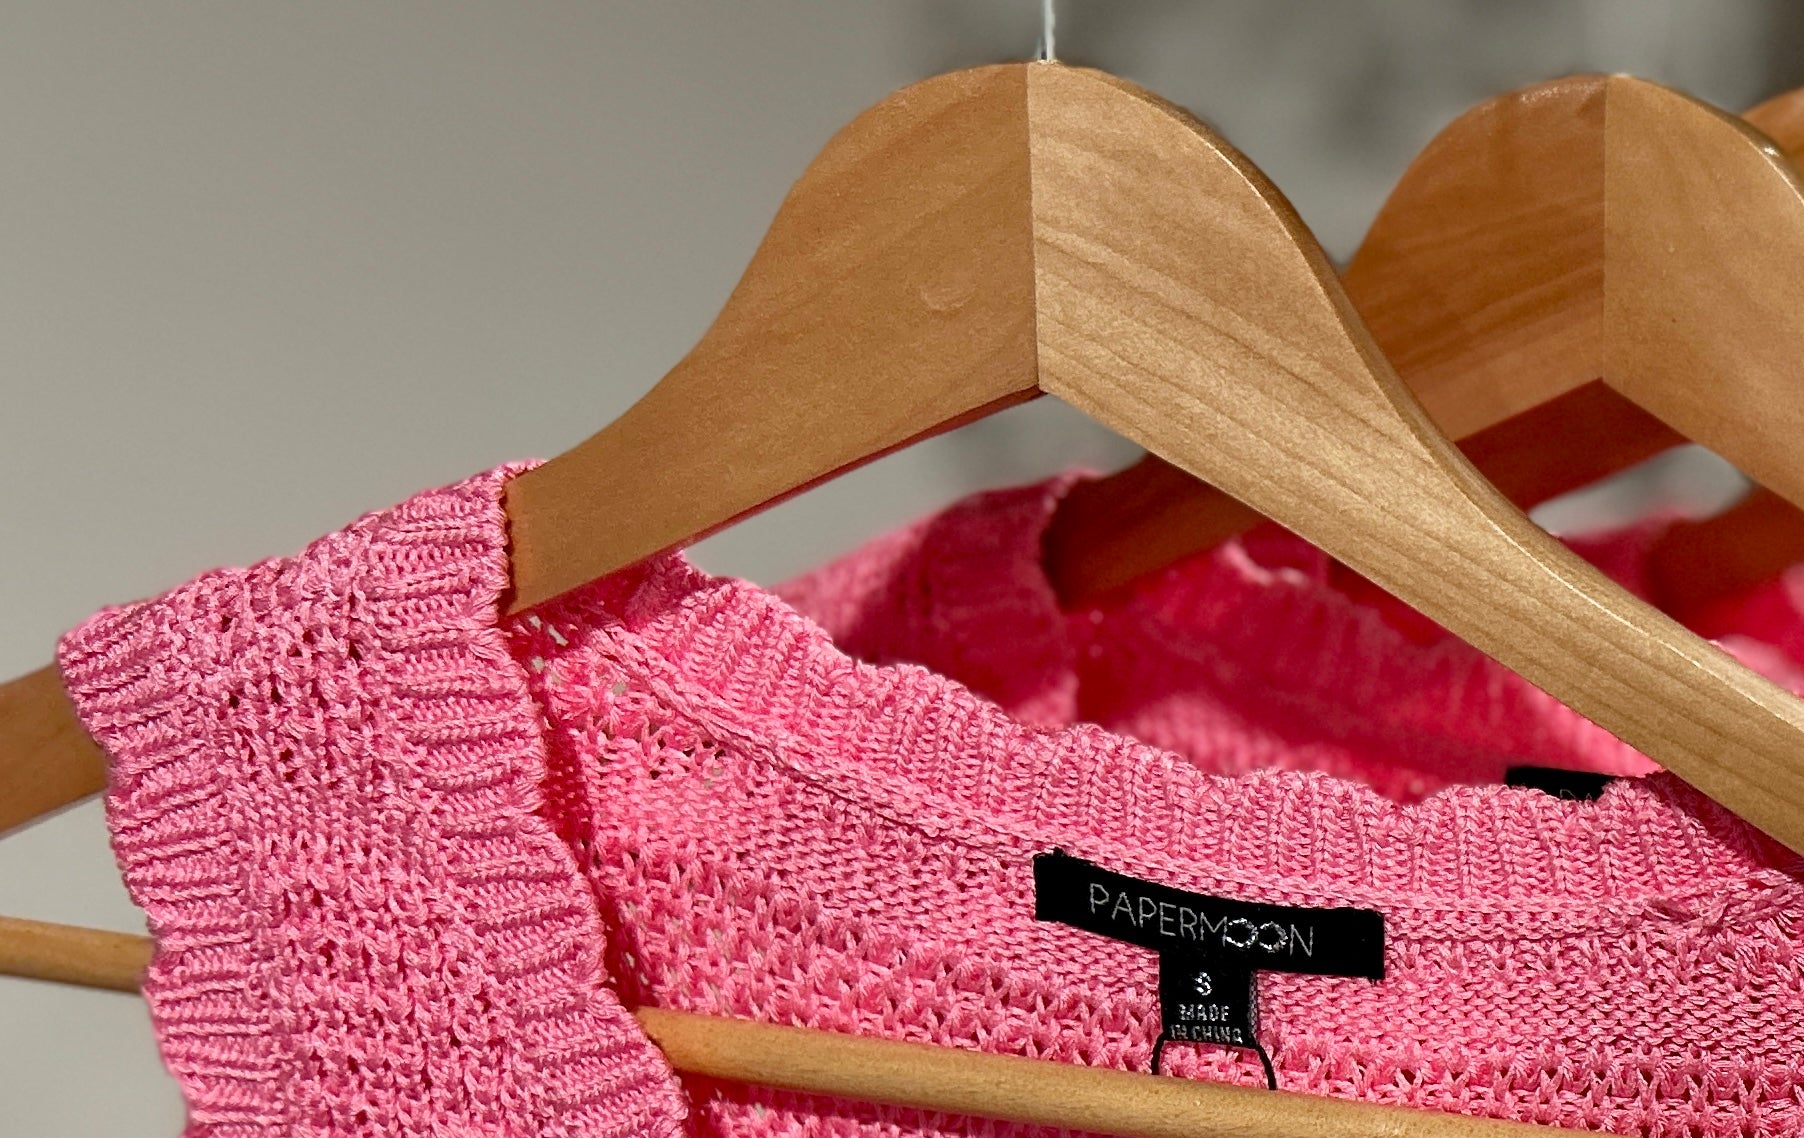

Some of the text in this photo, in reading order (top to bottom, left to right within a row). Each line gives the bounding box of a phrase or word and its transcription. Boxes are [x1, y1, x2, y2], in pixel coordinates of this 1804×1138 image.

[1089, 883, 1315, 957] PAPERMOON
[1193, 972, 1212, 996] S
[1179, 1004, 1230, 1021] MADE
